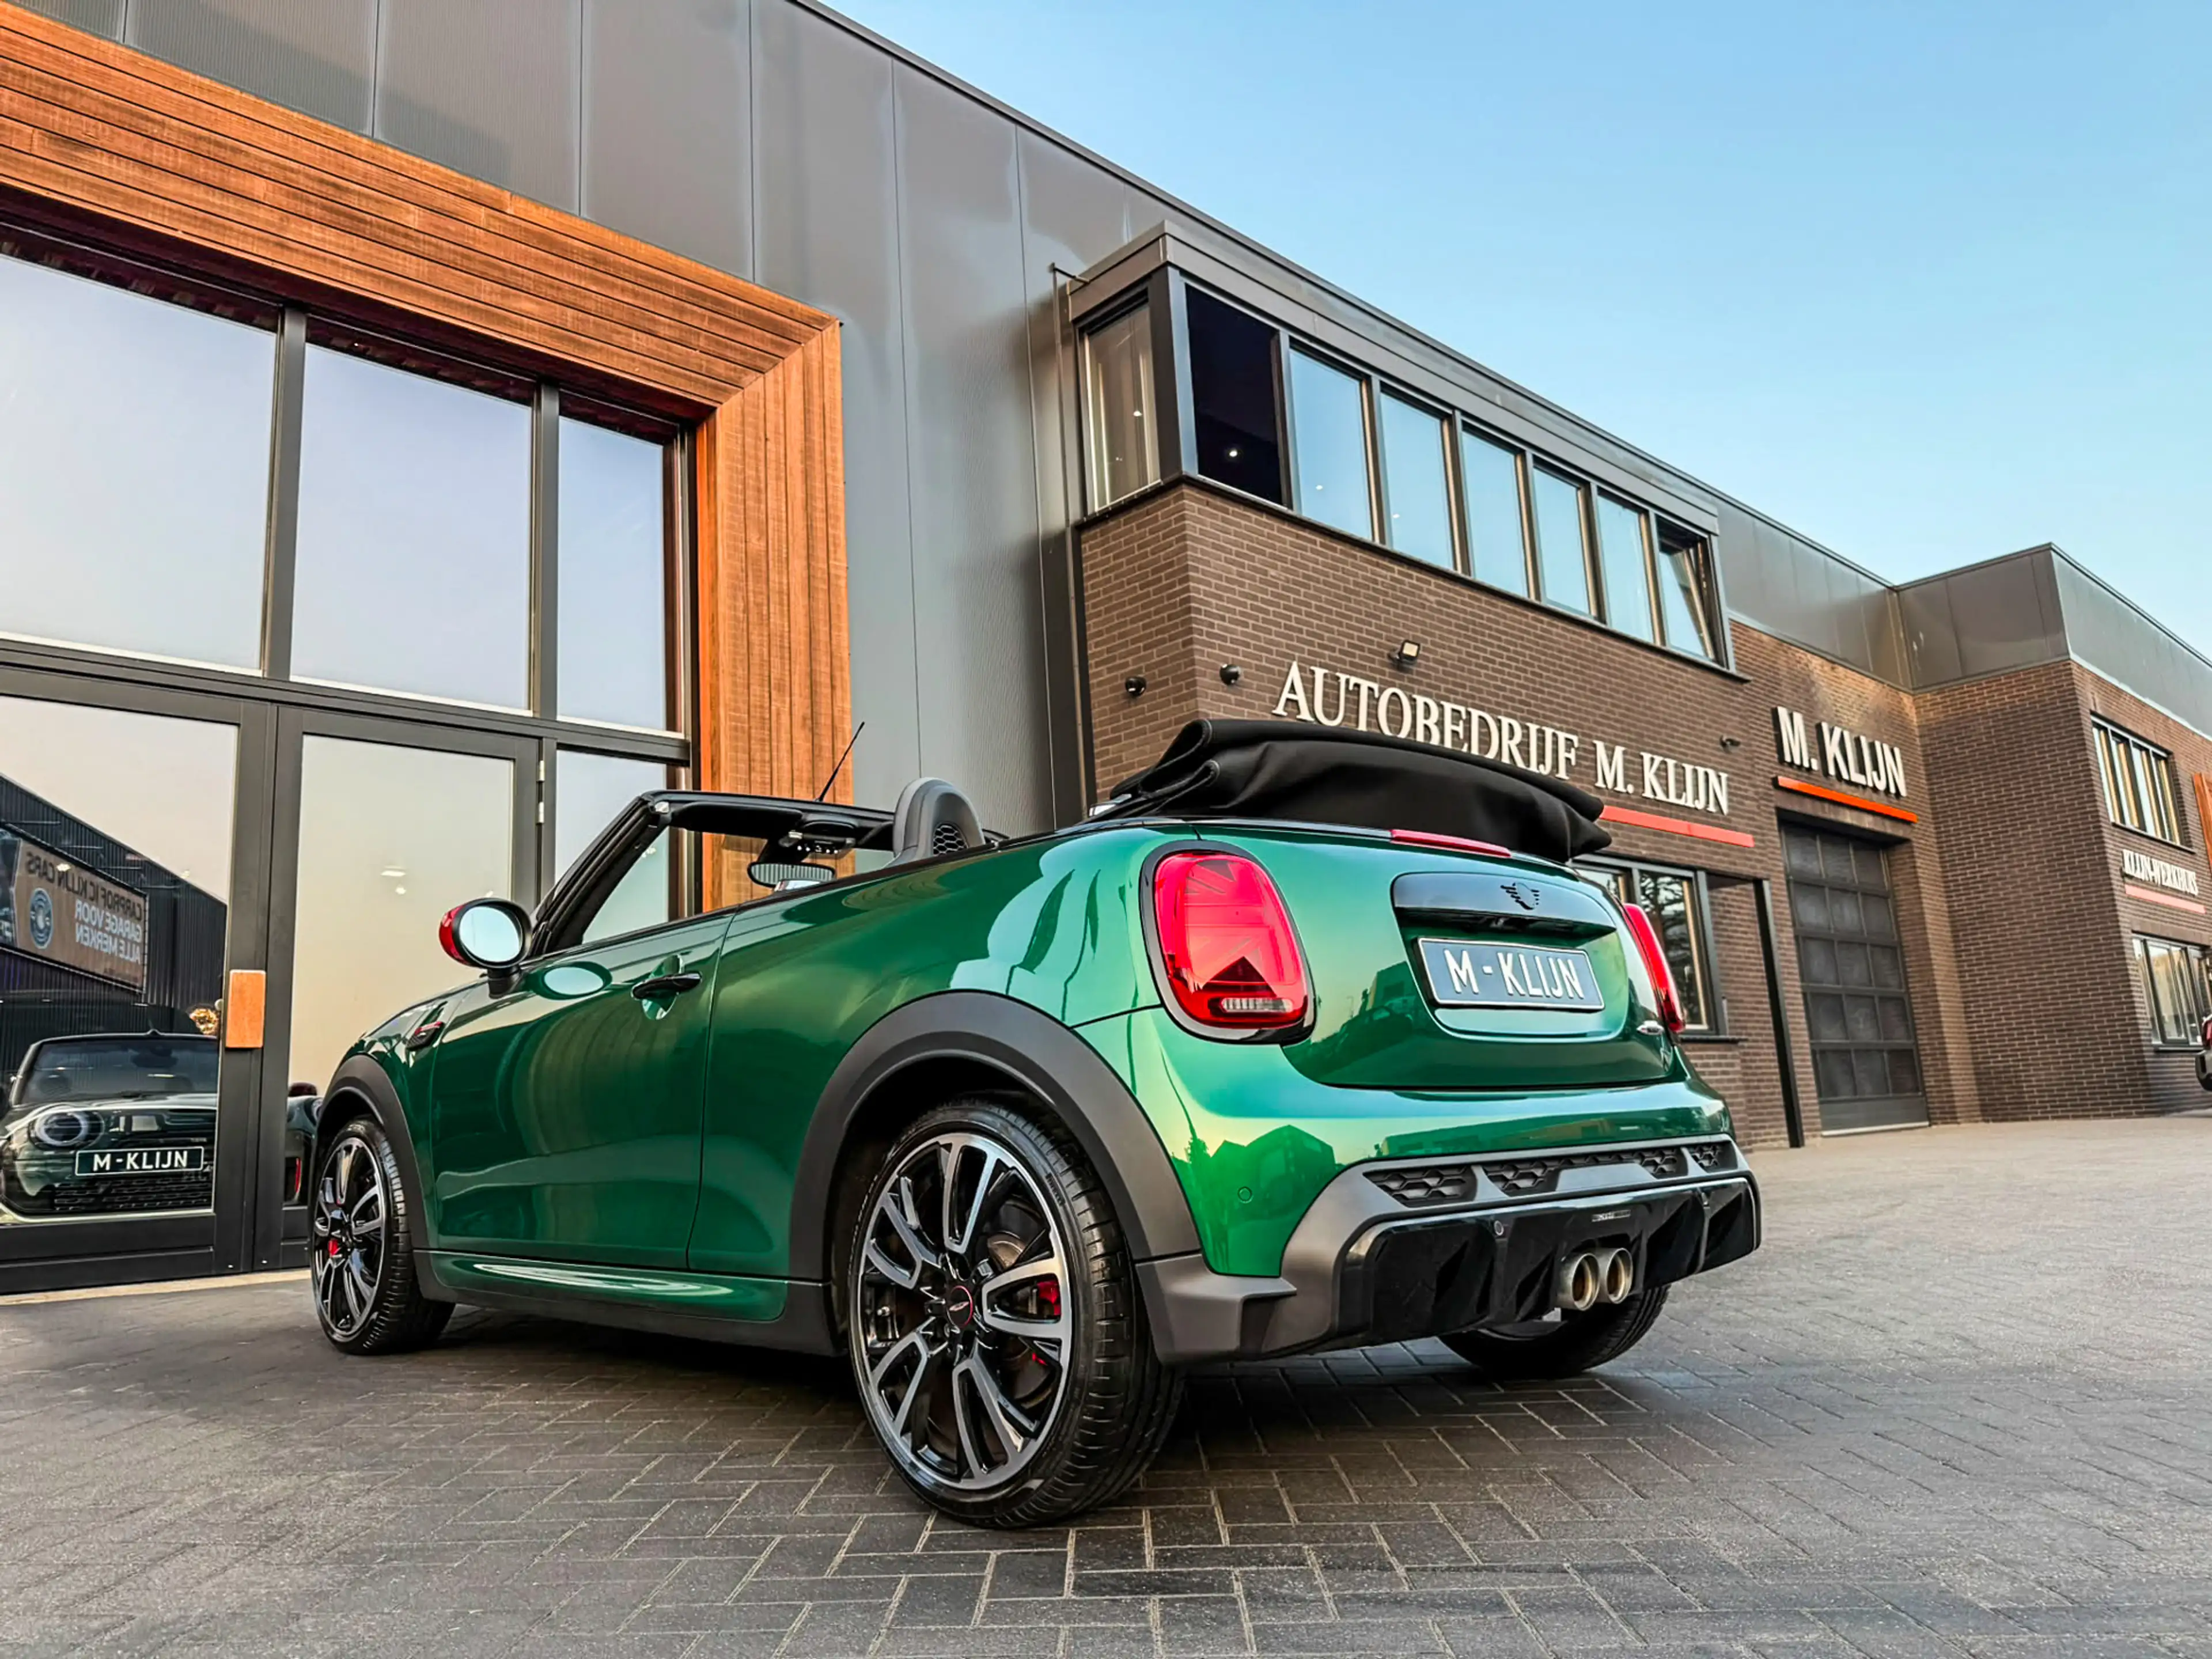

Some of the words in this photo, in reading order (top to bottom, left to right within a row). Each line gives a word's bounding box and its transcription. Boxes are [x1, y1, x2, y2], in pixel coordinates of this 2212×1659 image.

[1271, 661, 1578, 780] AUTOBEDRIJF
[1592, 740, 1635, 794] M.
[1639, 751, 1728, 816] KLIJN
[1773, 706, 1819, 771] M.
[1818, 721, 1907, 797] KLIJN
